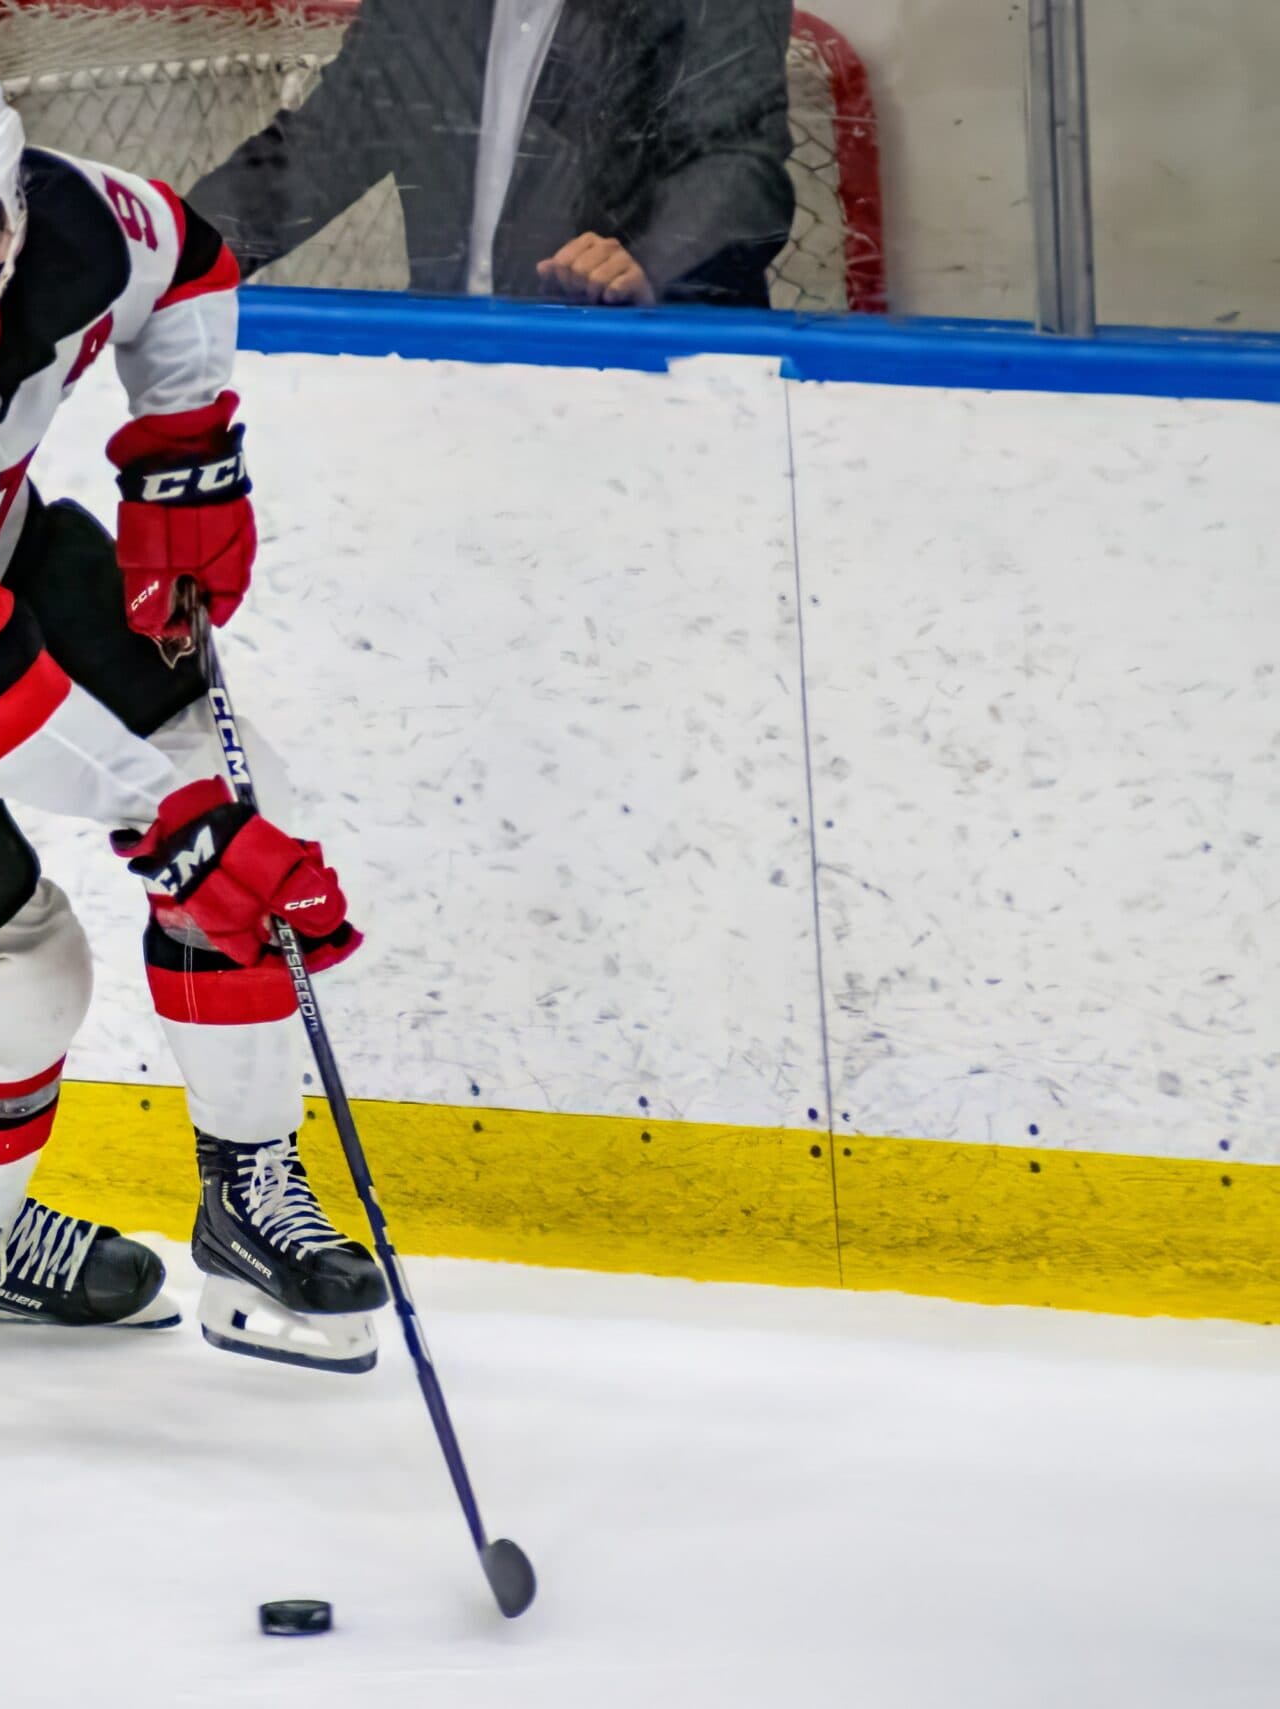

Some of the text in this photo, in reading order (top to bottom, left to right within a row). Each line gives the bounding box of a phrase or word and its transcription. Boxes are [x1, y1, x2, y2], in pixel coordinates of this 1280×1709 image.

[142, 451, 246, 501] CC
[131, 580, 160, 612] CCM
[208, 688, 251, 784] CCM
[142, 825, 216, 896] CM
[284, 895, 327, 911] CCM
[276, 917, 317, 1017] JETSPEED
[231, 1241, 273, 1279] BAUER
